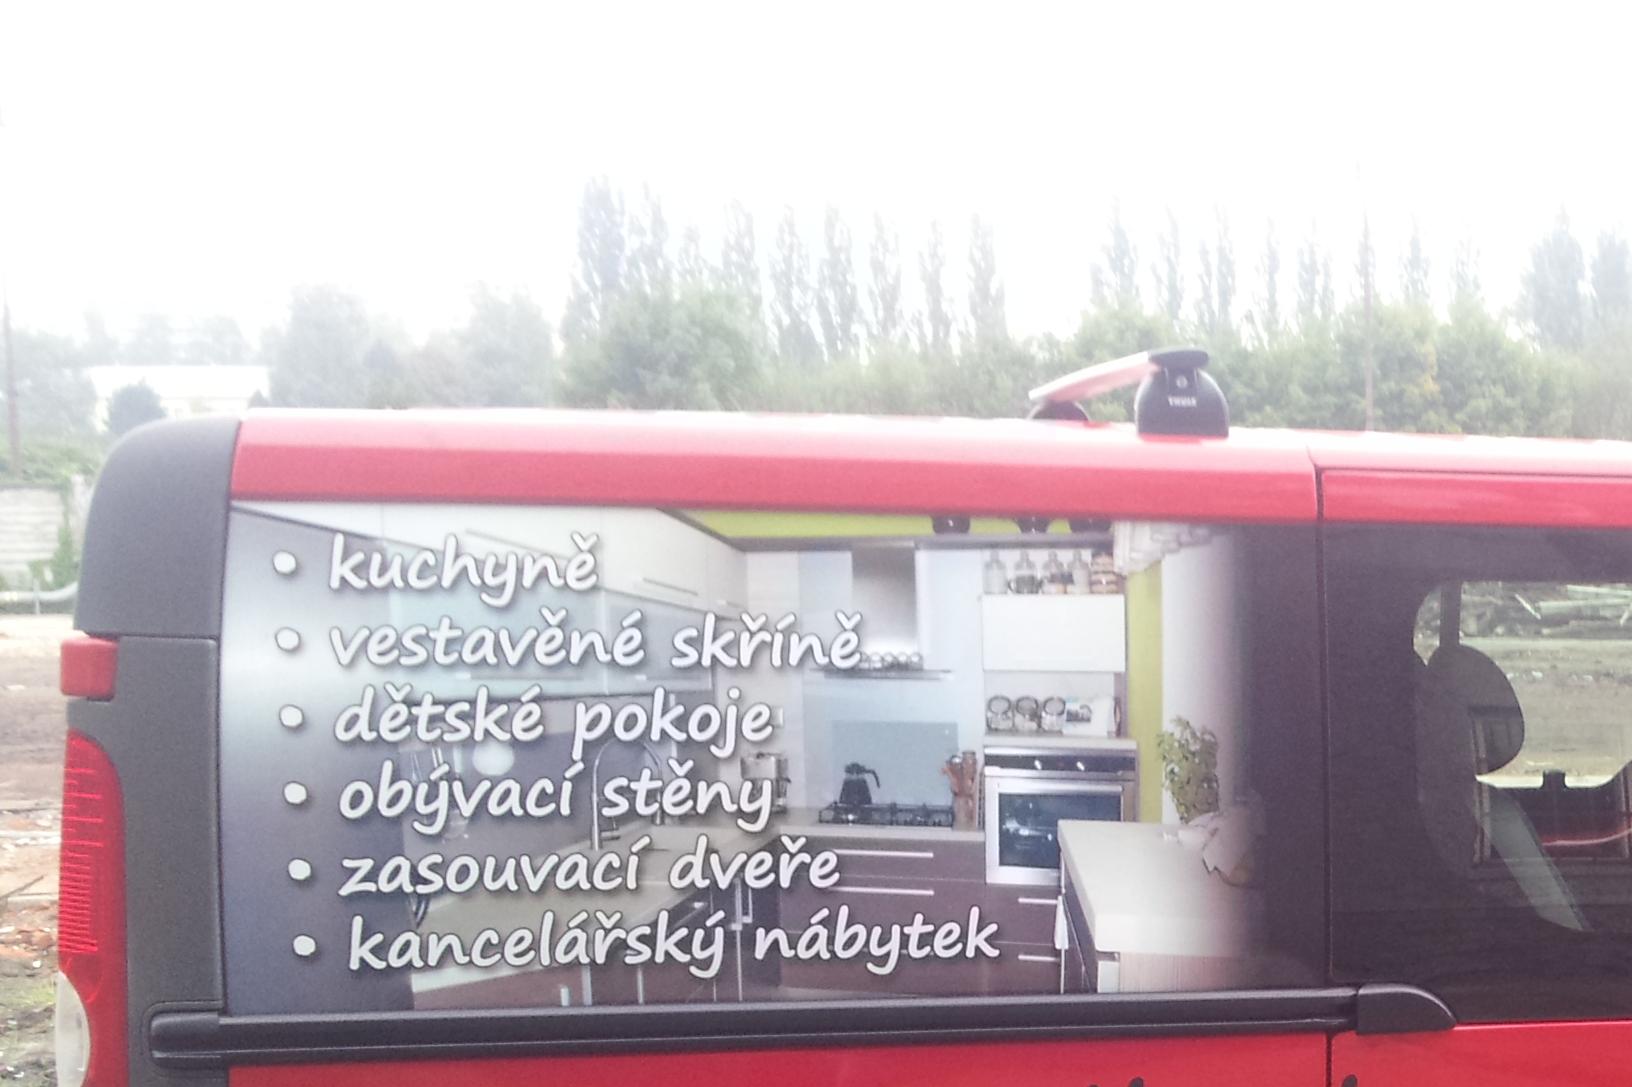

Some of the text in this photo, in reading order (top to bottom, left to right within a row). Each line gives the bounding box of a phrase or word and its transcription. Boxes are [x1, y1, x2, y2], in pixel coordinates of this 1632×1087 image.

[329, 532, 600, 607] kuchyně
[329, 607, 864, 671] vestavěné skříně
[334, 682, 774, 762] dětské pokoje
[338, 758, 773, 835] obývací stěny
[338, 834, 842, 897] zasouvací dveře
[347, 906, 1001, 980] kancelářský nábytek
